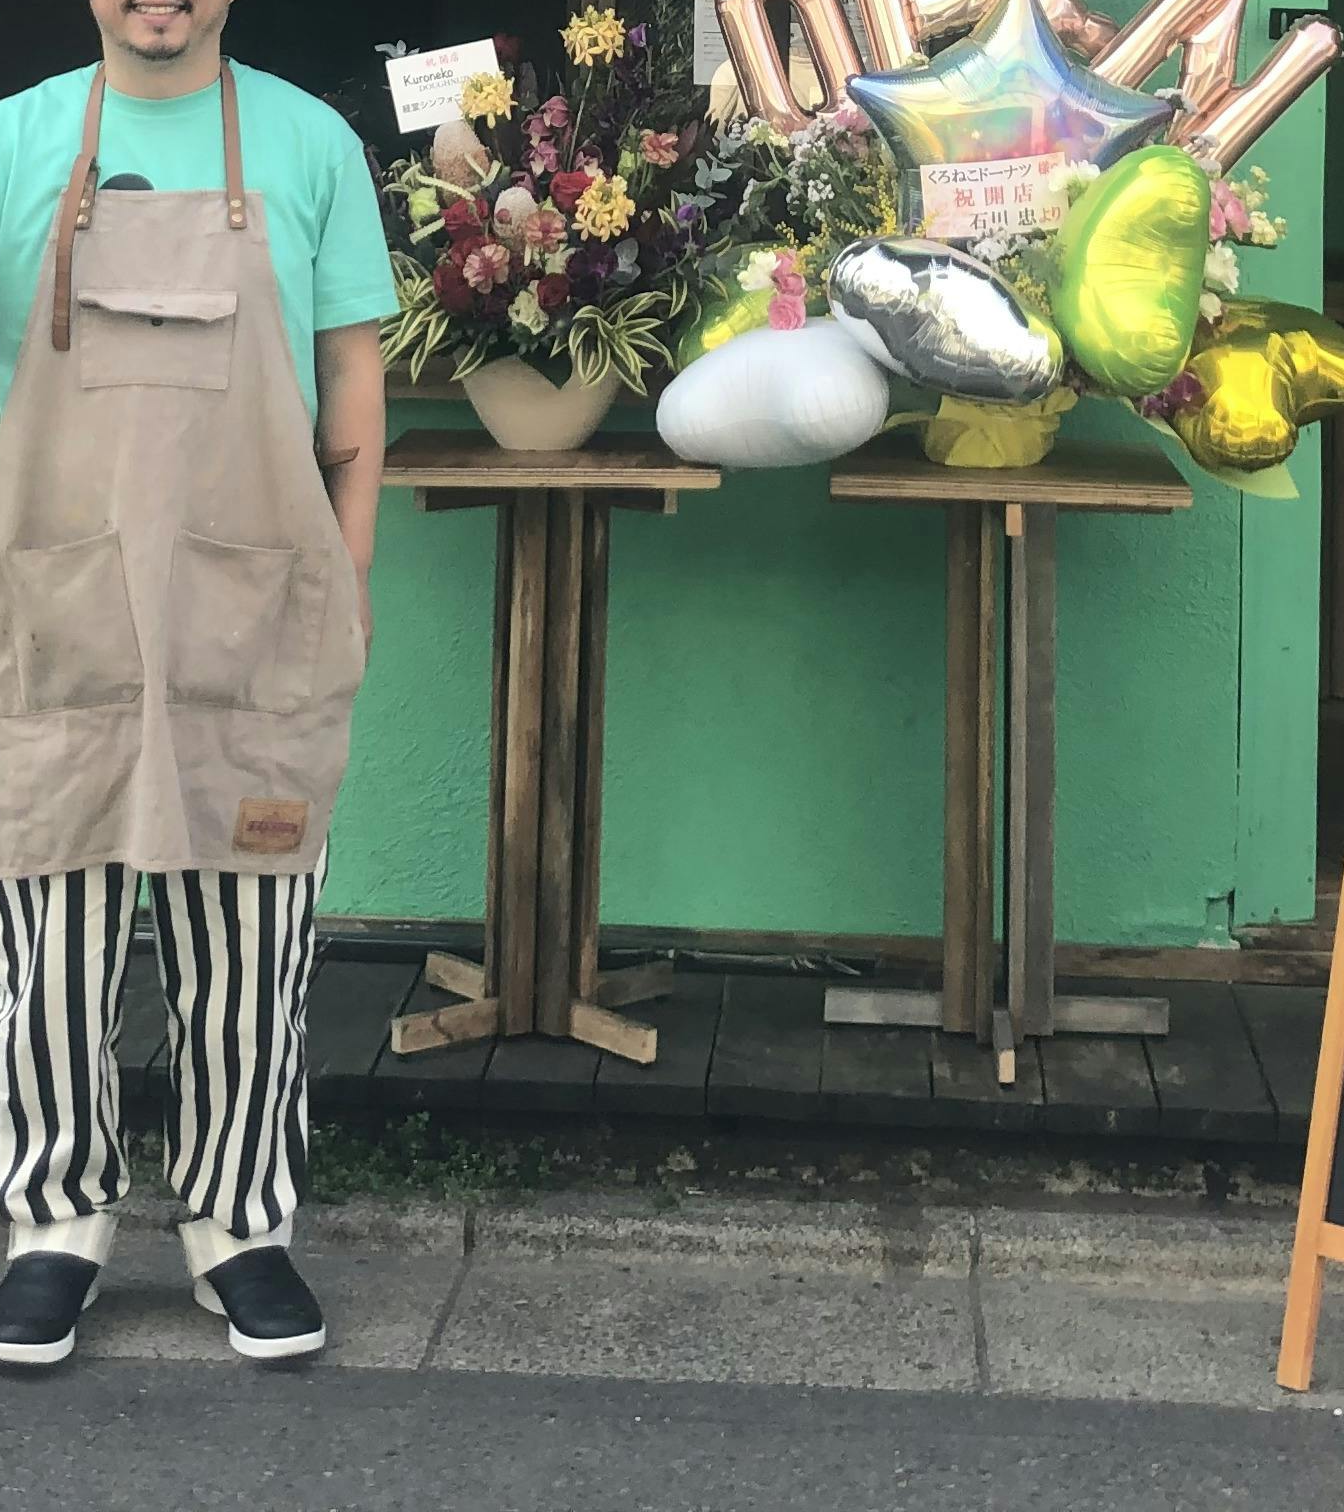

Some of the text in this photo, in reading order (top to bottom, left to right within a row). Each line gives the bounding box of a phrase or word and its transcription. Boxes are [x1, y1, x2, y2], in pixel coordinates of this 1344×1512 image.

[403, 68, 454, 87] Kuroneko
[928, 163, 1032, 184] くろねこドーナツ
